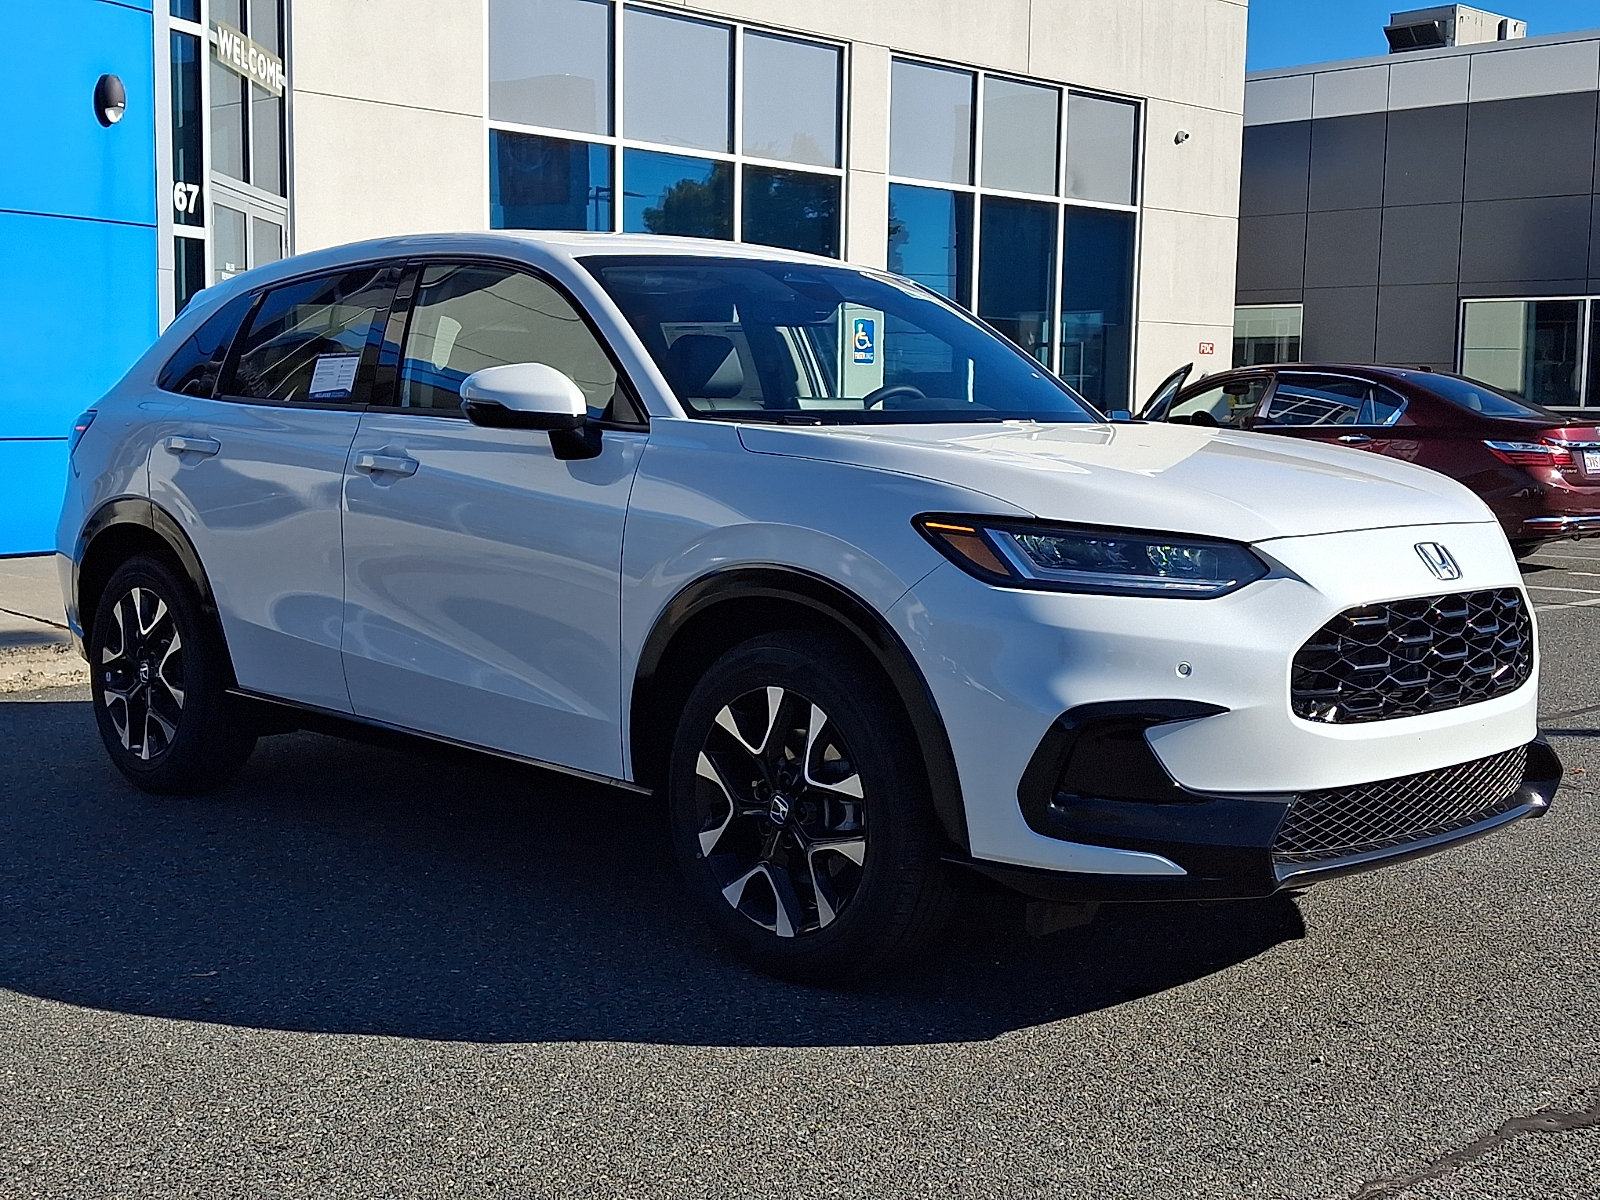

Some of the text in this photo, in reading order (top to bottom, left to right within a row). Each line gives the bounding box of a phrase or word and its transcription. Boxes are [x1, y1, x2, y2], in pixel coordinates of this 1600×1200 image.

[217, 26, 282, 90] WELCOME
[174, 181, 200, 214] 67
[1200, 343, 1213, 354] FDC
